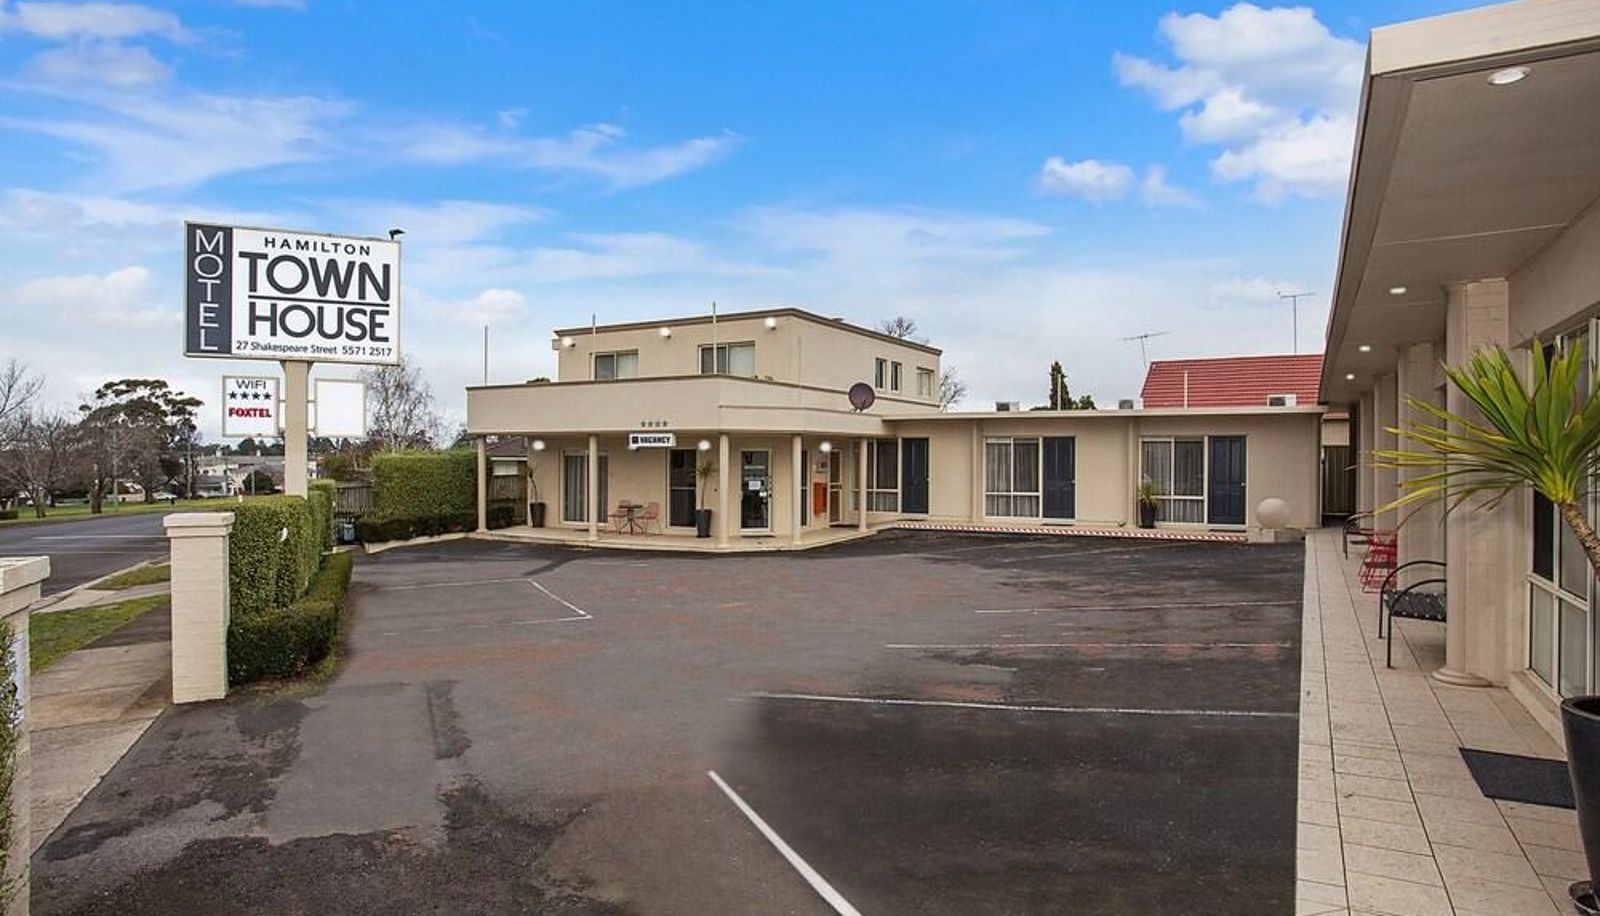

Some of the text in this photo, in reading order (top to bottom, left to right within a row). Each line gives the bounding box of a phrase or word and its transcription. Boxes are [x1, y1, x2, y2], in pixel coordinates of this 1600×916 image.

[265, 237, 370, 256] HAMILTON
[239, 251, 391, 302] TOWN
[194, 229, 224, 350] MOTEL
[249, 302, 390, 343] HOUSE
[236, 340, 392, 357] 27 Shakespeare Street 5571 2517
[228, 407, 272, 418] FOXTEL
[640, 436, 670, 444] VACANCY
